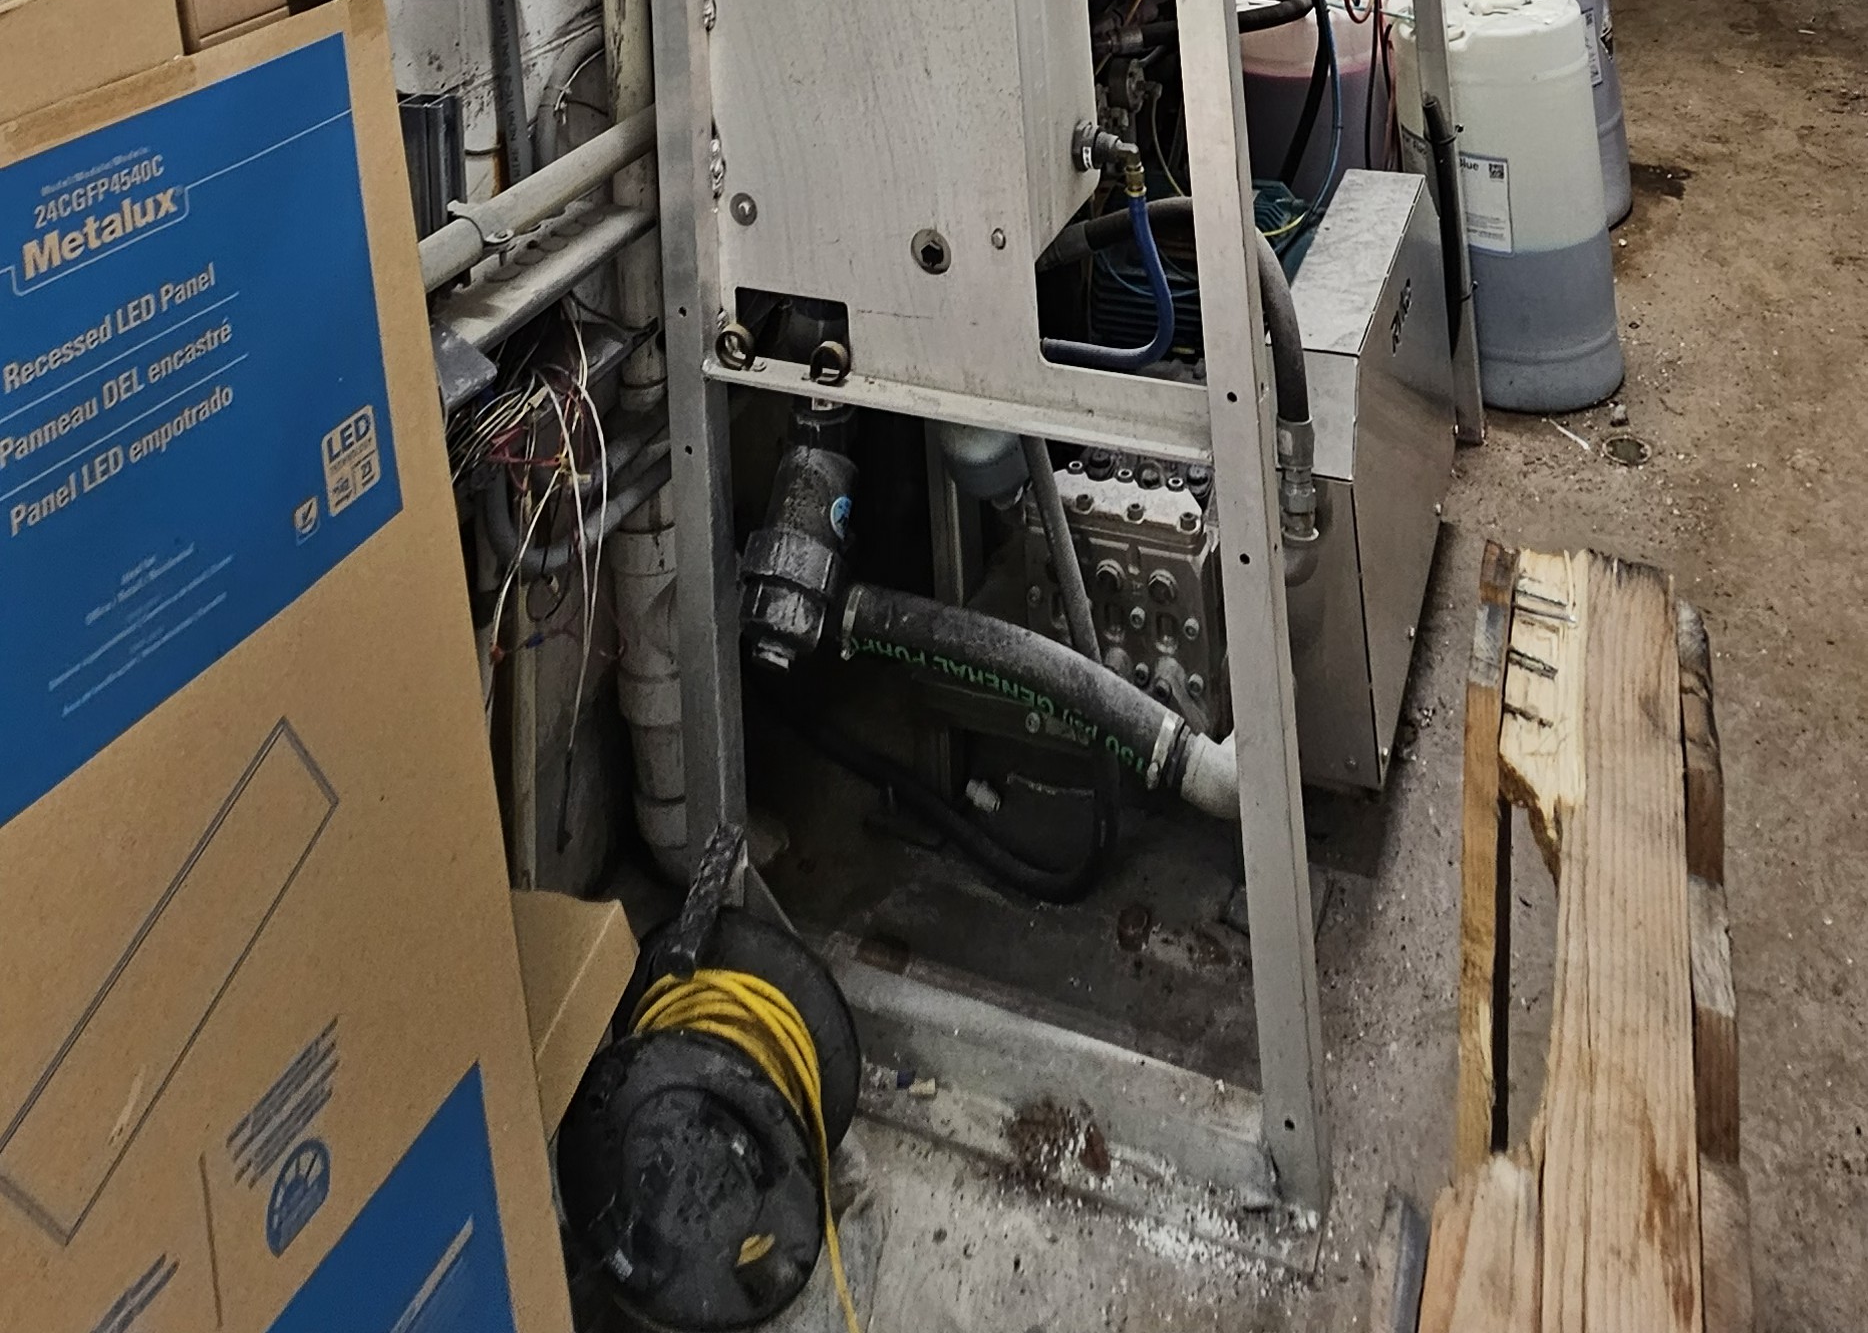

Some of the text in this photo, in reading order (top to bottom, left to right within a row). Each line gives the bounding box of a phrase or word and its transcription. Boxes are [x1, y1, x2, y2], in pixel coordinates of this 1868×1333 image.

[22, 185, 178, 282] Metalux
[34, 154, 164, 229] 24CGFP4540C
[3, 262, 215, 394] Recessed LED Panel
[0, 317, 232, 469] Panneau DEL encastré
[327, 412, 372, 464] LED
[10, 384, 233, 539] Panel LED empotrado
